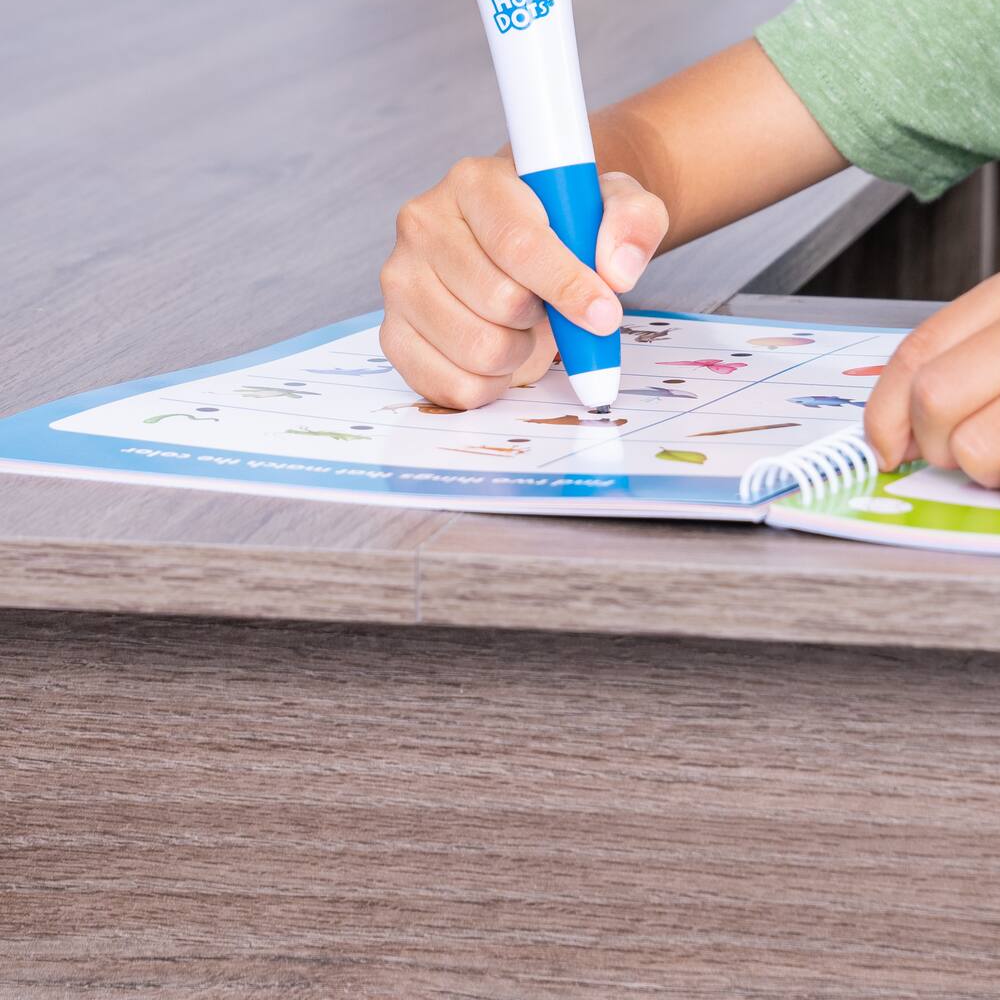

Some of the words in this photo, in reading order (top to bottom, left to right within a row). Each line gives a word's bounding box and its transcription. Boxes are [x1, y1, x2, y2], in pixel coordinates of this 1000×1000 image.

[121, 447, 191, 459] color
[198, 455, 240, 465] the
[247, 460, 332, 473] match
[335, 467, 393, 479] that
[399, 472, 485, 484] things
